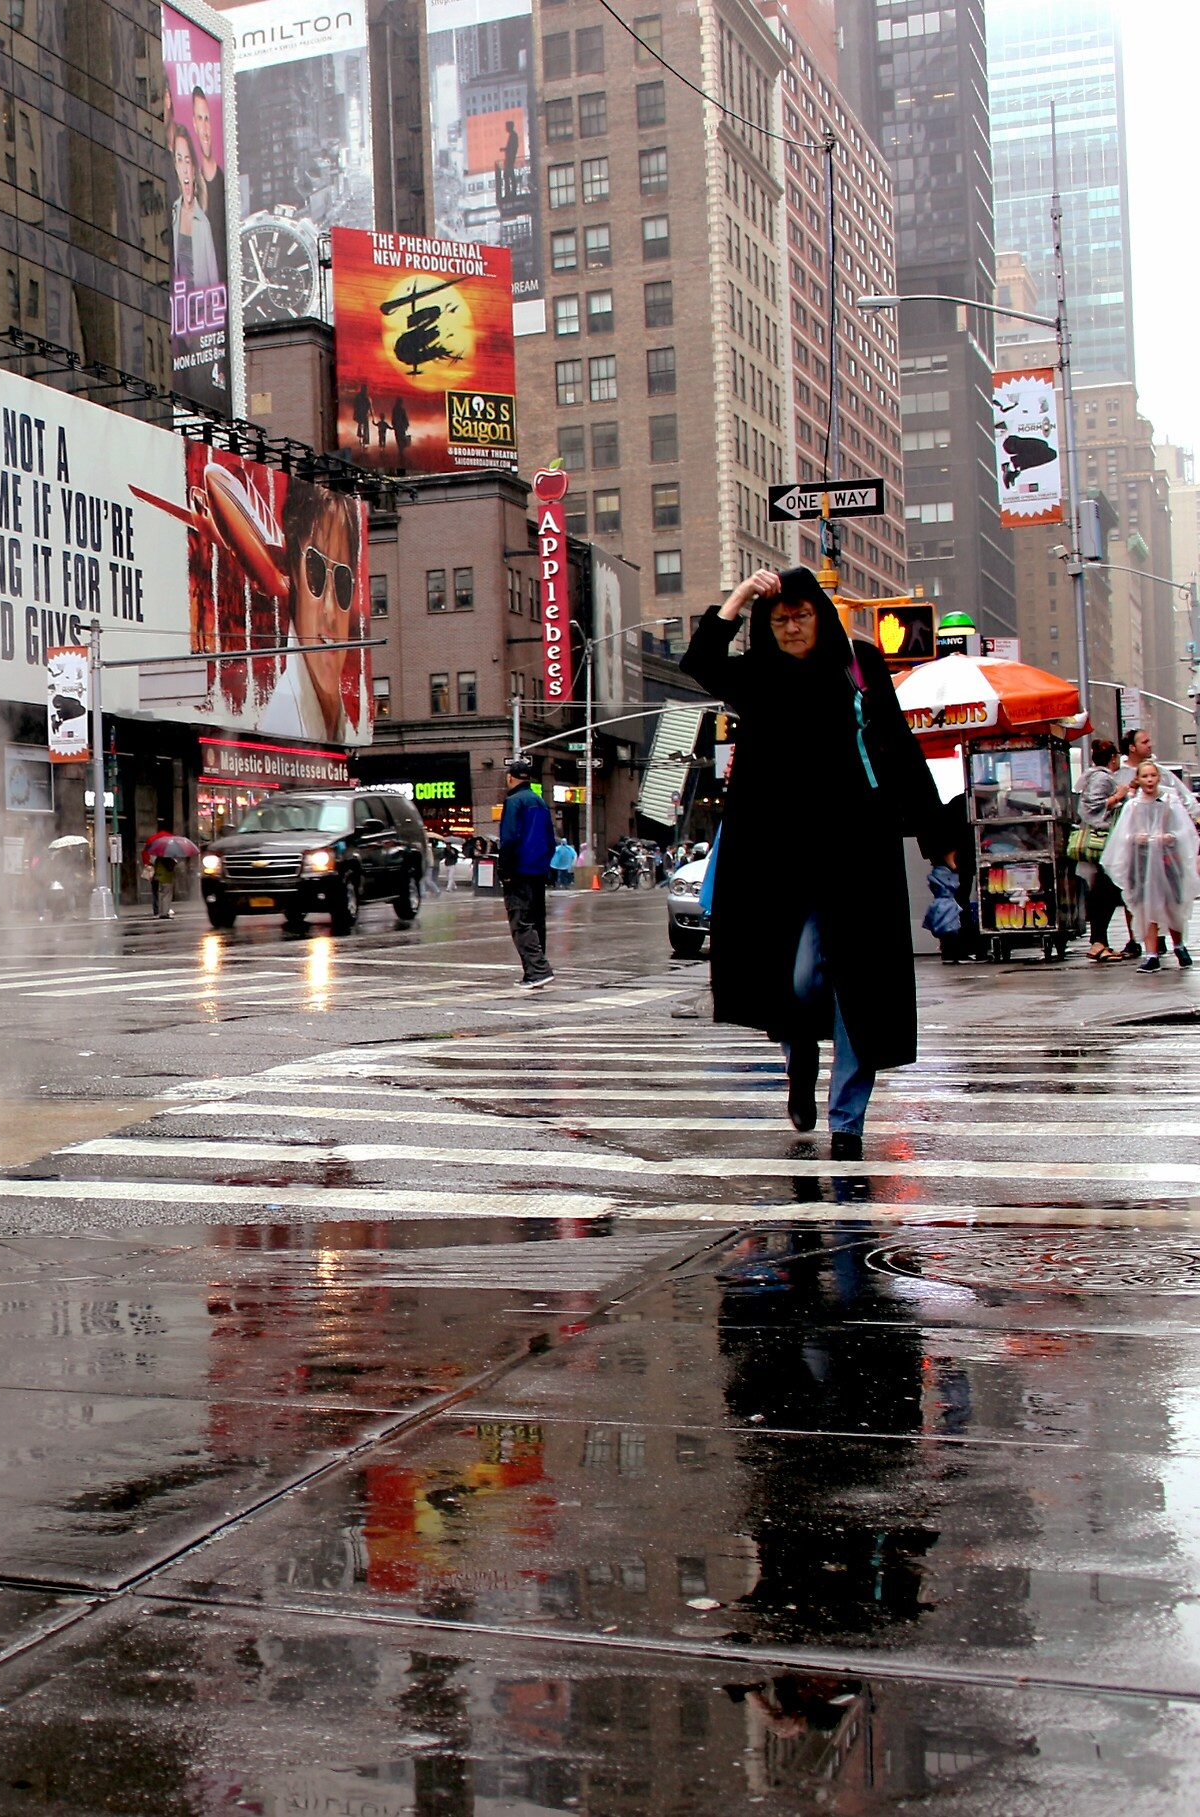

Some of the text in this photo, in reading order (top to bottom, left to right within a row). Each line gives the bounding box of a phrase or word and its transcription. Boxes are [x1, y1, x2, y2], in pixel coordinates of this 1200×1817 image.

[175, 62, 221, 95] NOISE
[373, 249, 402, 267] NEW
[399, 238, 483, 260] PHENOMENAL
[170, 281, 227, 335] ice
[200, 330, 226, 348] SEPT 25
[173, 355, 190, 371] MON
[191, 353, 196, 367] &
[196, 349, 213, 364] TUES
[452, 416, 512, 444] Saigon
[2, 406, 46, 477] NOT
[57, 426, 70, 484] A
[492, 449, 518, 459] THEATRE
[786, 490, 869, 510] ONE WAY
[33, 480, 51, 540] IF
[61, 487, 135, 562] YOU'RE
[33, 543, 52, 604] IT
[63, 550, 101, 613] FOR
[109, 562, 144, 622] THE
[538, 511, 562, 696] Applebee's
[26, 606, 81, 667] GUYS
[936, 637, 964, 646] inkNYC
[902, 701, 988, 730] UTS4NUTS
[220, 751, 349, 782] Majestic Delicatessen Café
[415, 782, 456, 800] COFFEE
[995, 901, 1049, 929] NUTS
